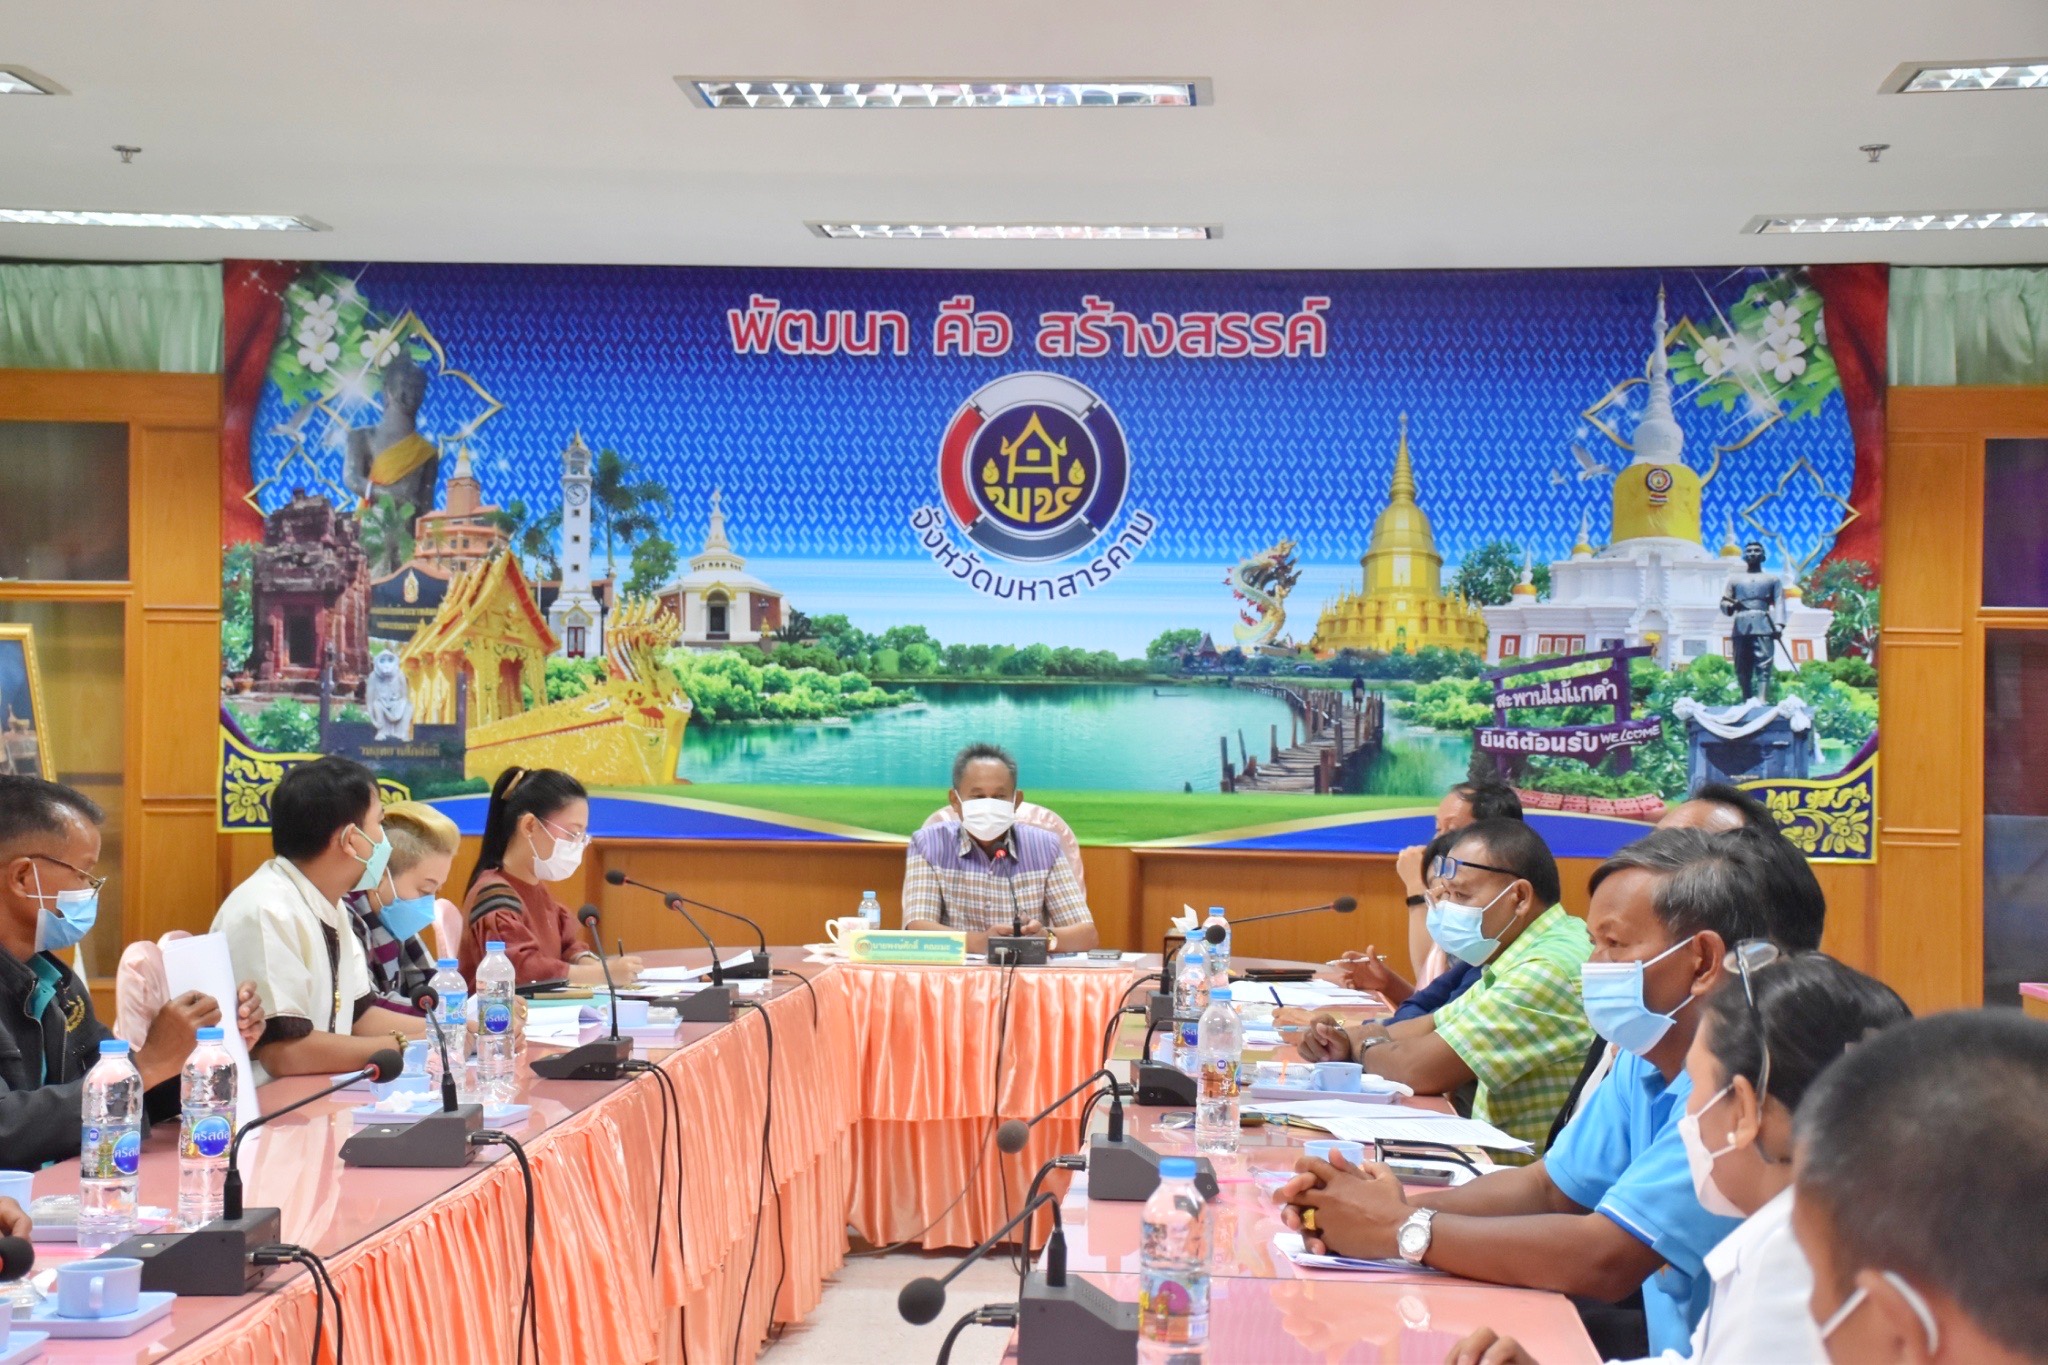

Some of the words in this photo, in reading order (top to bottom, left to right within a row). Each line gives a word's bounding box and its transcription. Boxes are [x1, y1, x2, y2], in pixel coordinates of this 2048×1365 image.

[728, 294, 909, 356] พัฒนา
[933, 295, 1013, 357] คือ
[1036, 296, 1331, 358] สร้างสรรค์
[910, 502, 1158, 602] จังหวัดมหาสารคาม
[1495, 678, 1618, 709] สะพานไม้แกดำ
[1480, 730, 1599, 752] ยินดีต้อนรับ
[1600, 724, 1661, 744] WELCOME
